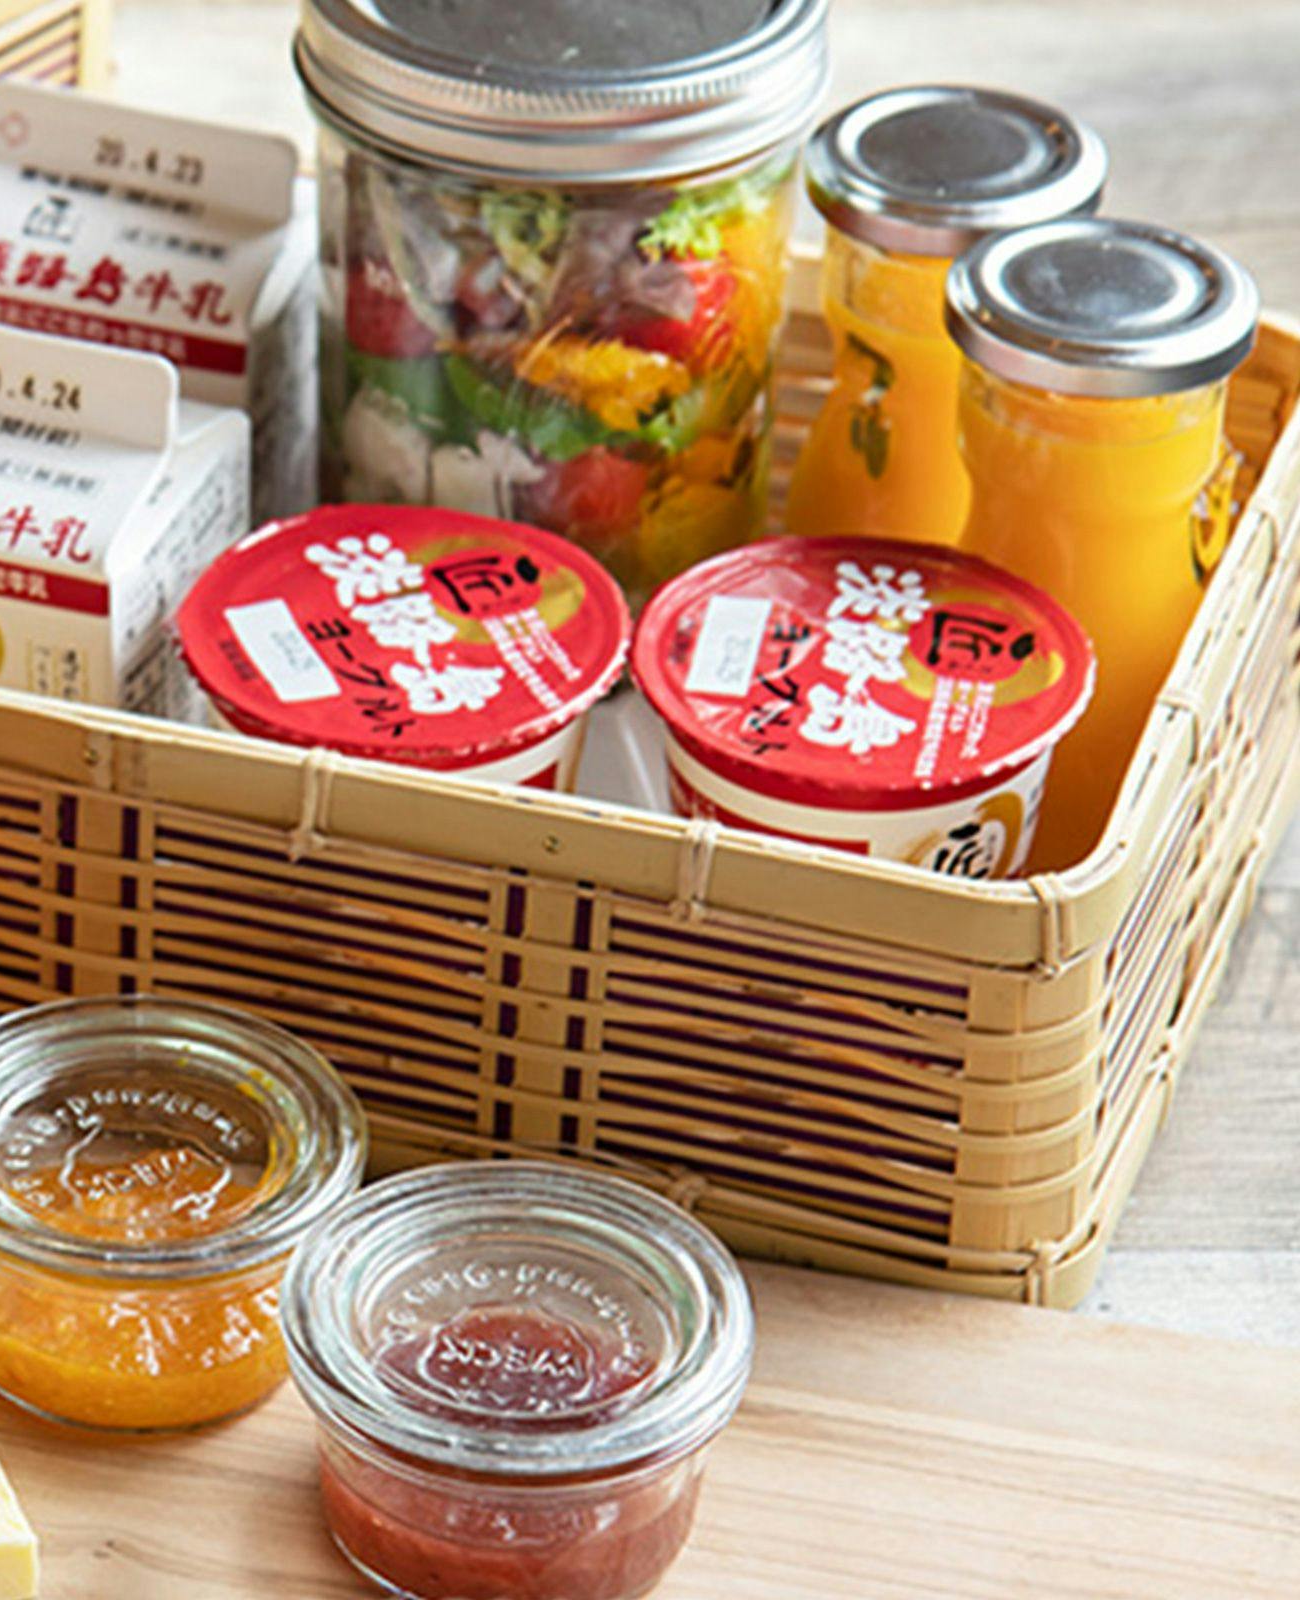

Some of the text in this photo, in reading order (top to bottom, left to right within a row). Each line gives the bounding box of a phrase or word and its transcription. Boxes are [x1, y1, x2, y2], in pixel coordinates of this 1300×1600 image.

[304, 533, 506, 715] 淡路島
[305, 618, 416, 738] ヨーグルト
[741, 622, 812, 756] ヨーグルト
[799, 561, 933, 756] 淡路島
[438, 1335, 588, 1379] WECK
